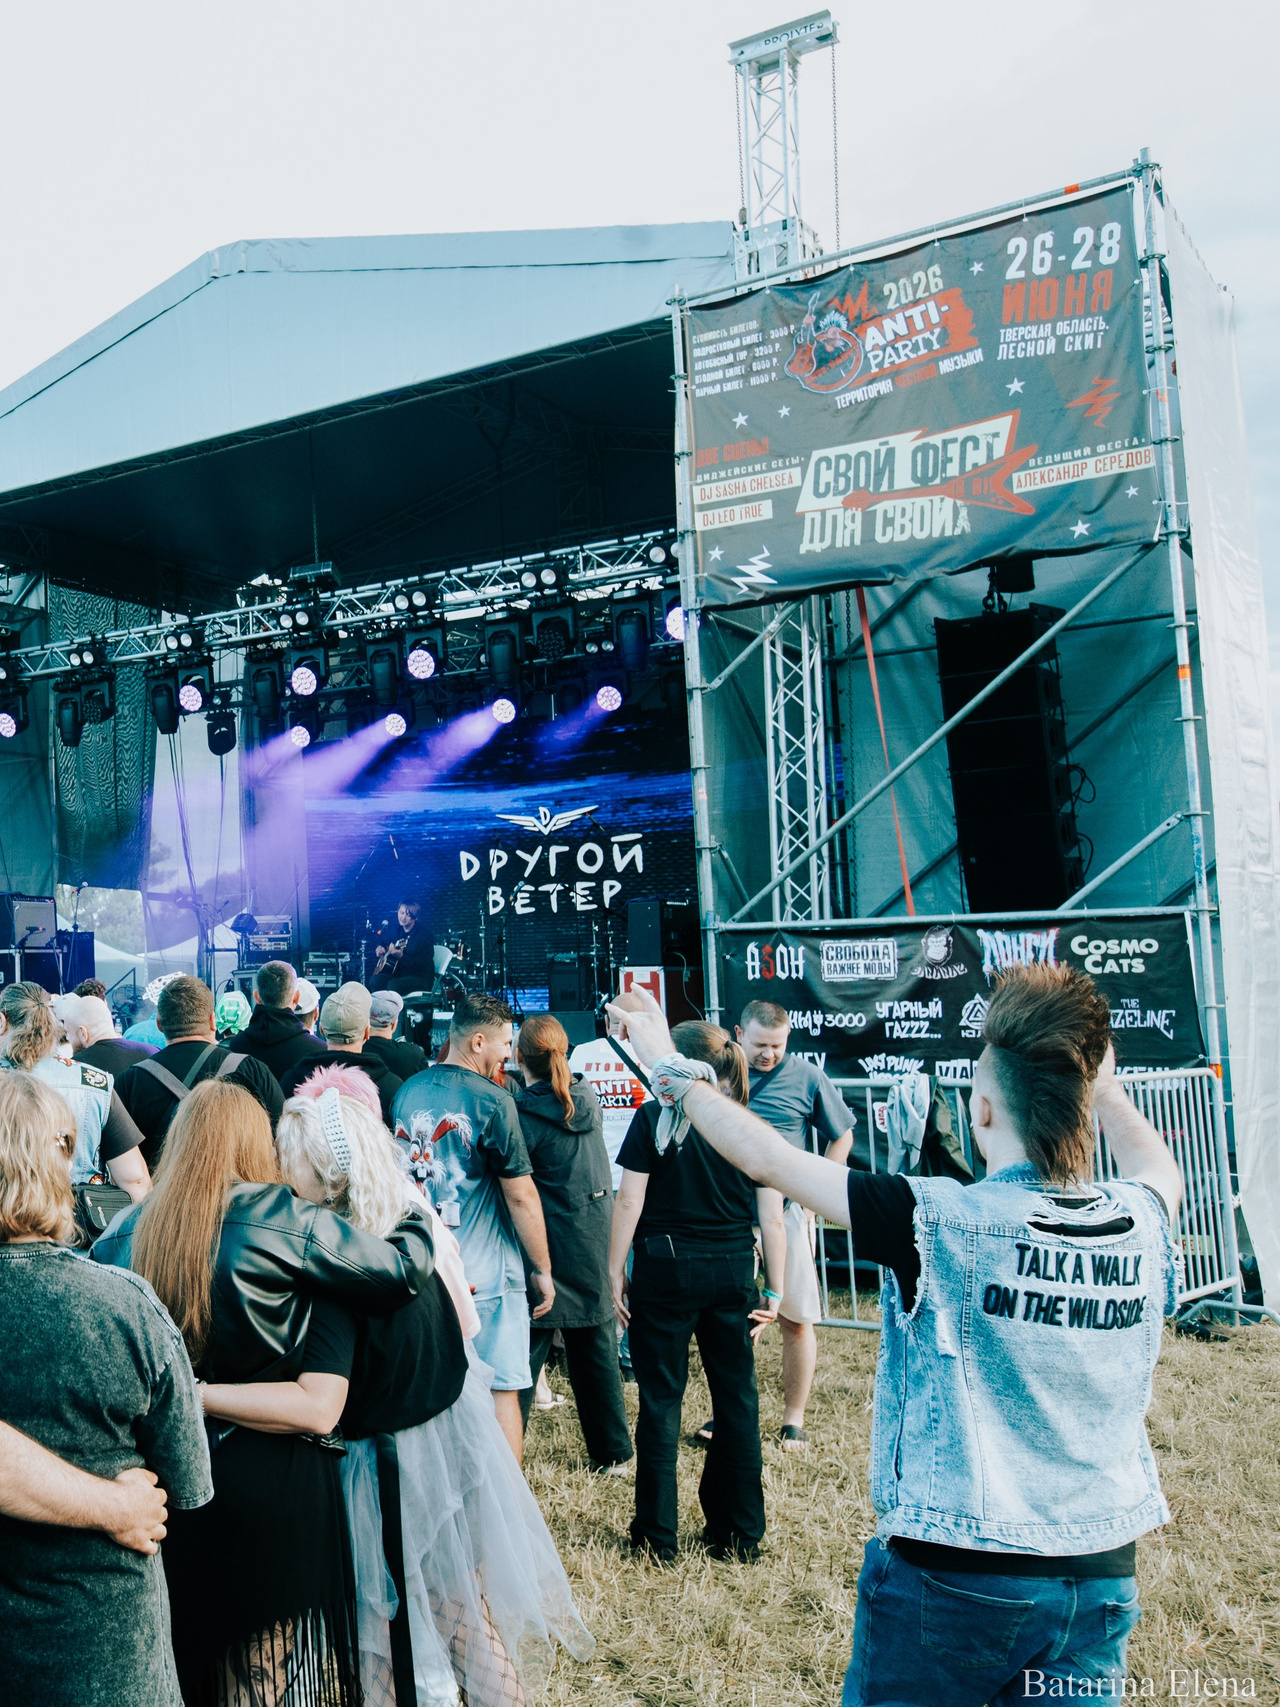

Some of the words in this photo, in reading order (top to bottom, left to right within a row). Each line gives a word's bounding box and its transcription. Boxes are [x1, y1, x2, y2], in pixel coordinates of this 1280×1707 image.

[1005, 222, 1121, 280] 26-28
[883, 263, 944, 310] 2026
[1002, 269, 1113, 325] ИЮНЯ
[864, 300, 950, 351] ANTI-
[999, 323, 1052, 343] ТВЕРСКАЯ
[742, 332, 763, 346] БИЛЕТ
[867, 327, 941, 374] PARTY
[997, 335, 1056, 361] ЛЕСНОЙ
[1065, 332, 1104, 352] СКИТ
[725, 365, 745, 378] БИЛЕТ
[834, 378, 893, 410] ТЕРРИТОРИЯ
[938, 348, 984, 375] МУЗЫКИ
[695, 383, 721, 397] ПАРНЫЙ
[723, 379, 743, 392] БИЛЕТ
[696, 446, 719, 468] ДВЕ
[812, 440, 896, 499] СВОЙ
[910, 431, 1001, 487] ФЕСТ
[1028, 446, 1092, 468] ВЕДУЩИЙ
[696, 462, 768, 484] ДИДЖЕЙСКИЕ
[1015, 461, 1088, 490] АЛЕКСАНДР
[700, 485, 713, 501] DJ
[715, 480, 747, 498] SASHA
[750, 471, 794, 492] CHELSEA
[703, 511, 716, 527] DJ
[718, 508, 736, 524] LEO
[740, 503, 764, 520] TRUE
[799, 508, 863, 554] ДЛЯ
[487, 880, 622, 916] ВЕТЕР
[825, 944, 891, 962] СВОБОДА
[1070, 935, 1160, 957] COSMO
[826, 962, 861, 976] ВАЖНЕЕ
[863, 961, 892, 976] МОДЫ
[1084, 954, 1146, 975] CATS
[875, 998, 943, 1020] УГАРНЫЙ
[1121, 998, 1140, 1009] THE
[824, 1012, 867, 1028] 3000
[885, 1056, 925, 1074] PUNK
[1015, 1242, 1069, 1284] TALK
[1071, 1252, 1086, 1285] A
[1091, 1253, 1142, 1287] WALK
[982, 1283, 1019, 1319] ON
[1023, 1289, 1067, 1327] THE
